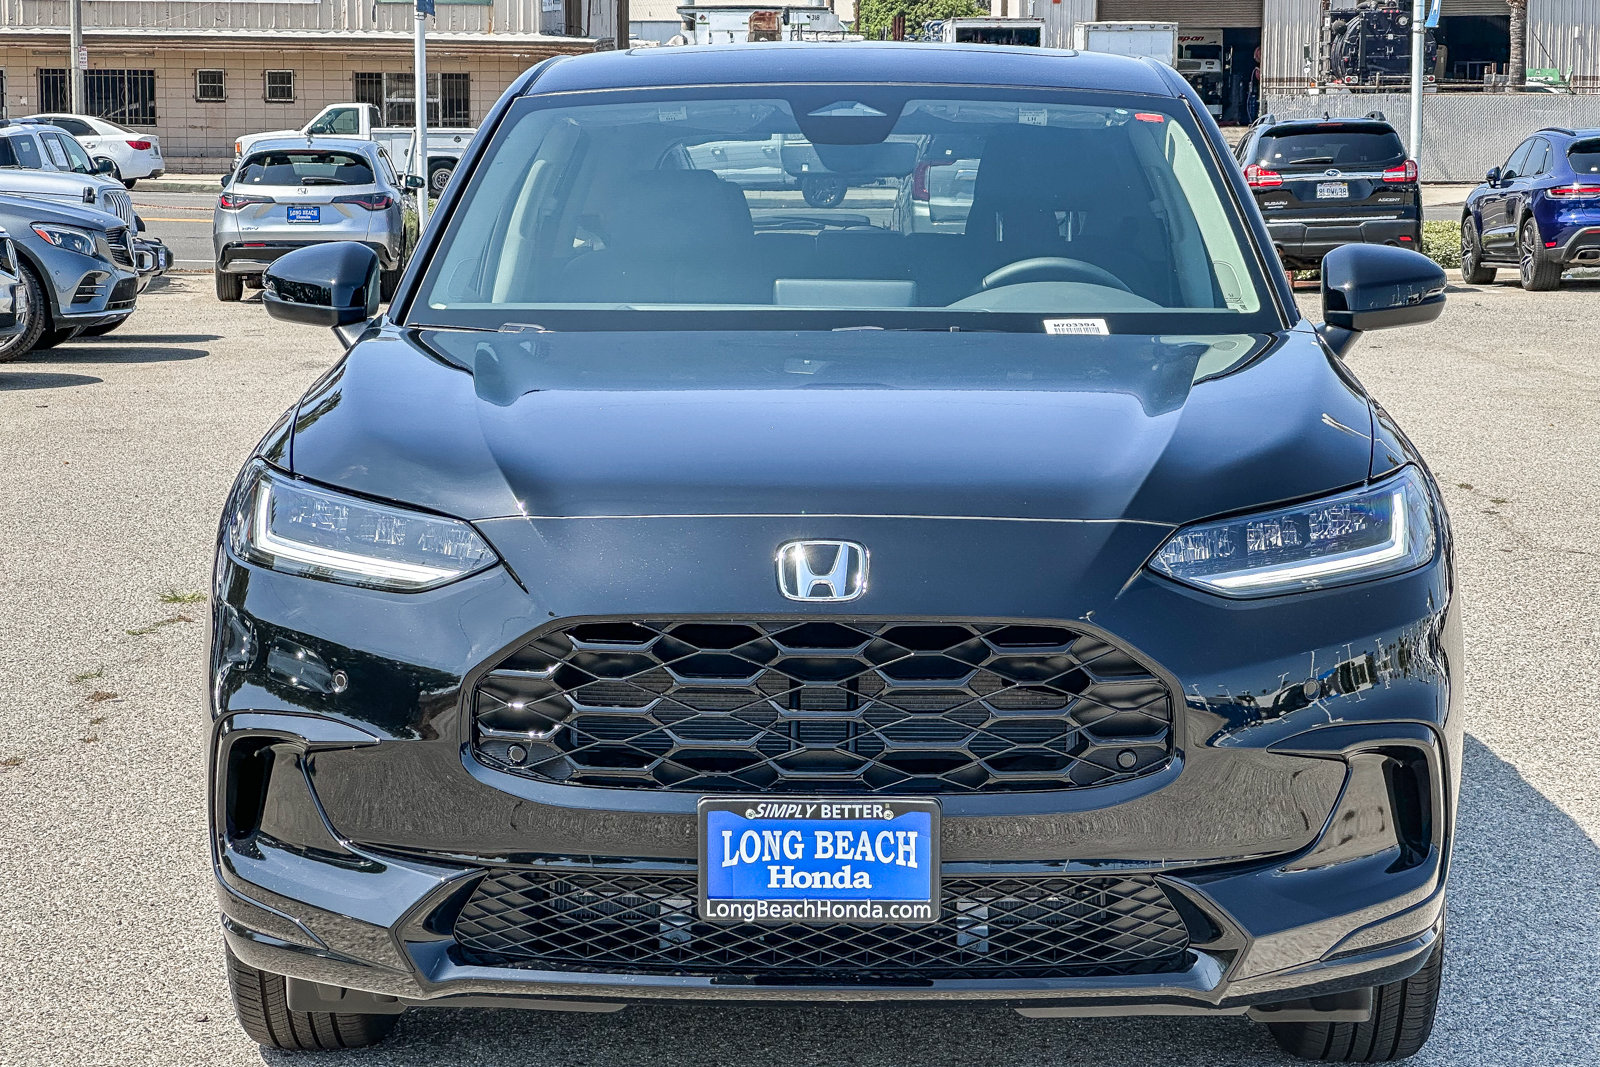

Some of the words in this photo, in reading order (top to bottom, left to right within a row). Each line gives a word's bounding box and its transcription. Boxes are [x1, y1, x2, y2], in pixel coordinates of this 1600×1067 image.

[755, 803, 817, 818] SIMPLY
[820, 804, 884, 819] BETTER
[721, 829, 805, 868] LONG
[814, 830, 919, 869] BEACH
[767, 864, 873, 889] Honda
[705, 898, 932, 922] LongBeachHonda.com
